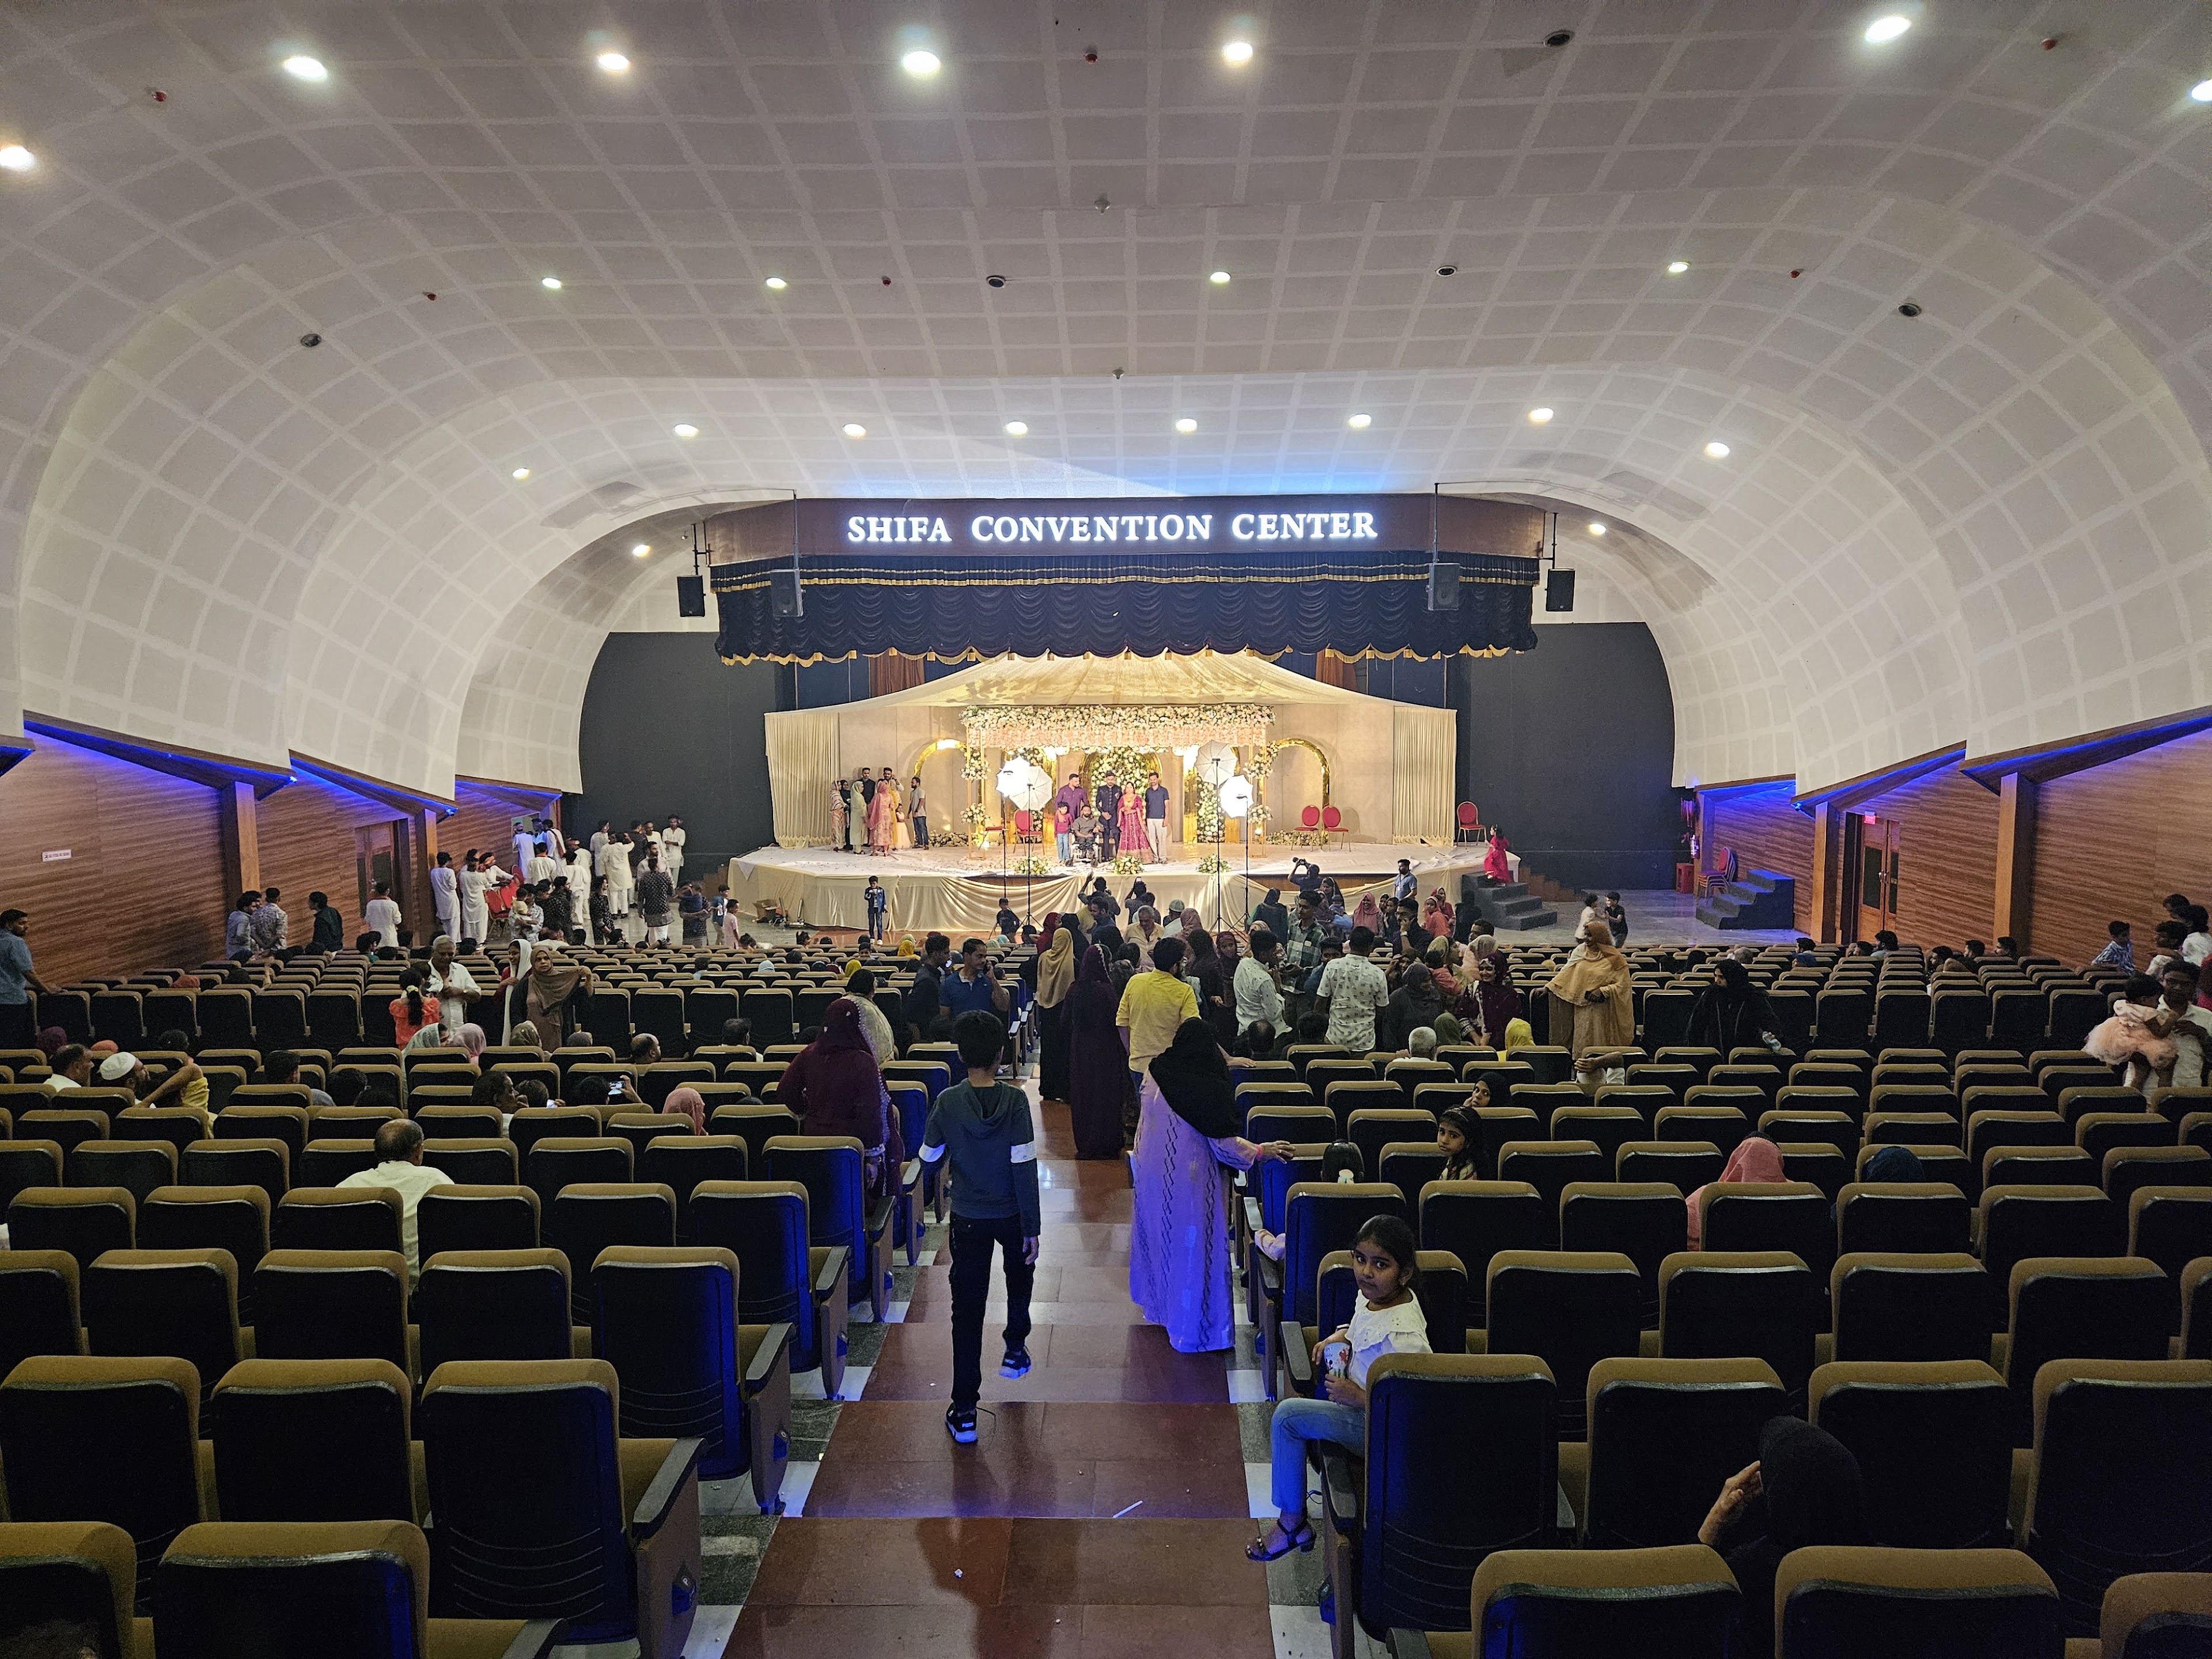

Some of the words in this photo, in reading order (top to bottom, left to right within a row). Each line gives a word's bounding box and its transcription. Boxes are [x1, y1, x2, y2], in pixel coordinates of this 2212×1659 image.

[847, 516, 952, 543] SHIFA
[971, 514, 1213, 542] CONVENTION
[1231, 512, 1378, 540] CENTER
[682, 1577, 688, 1586] P
